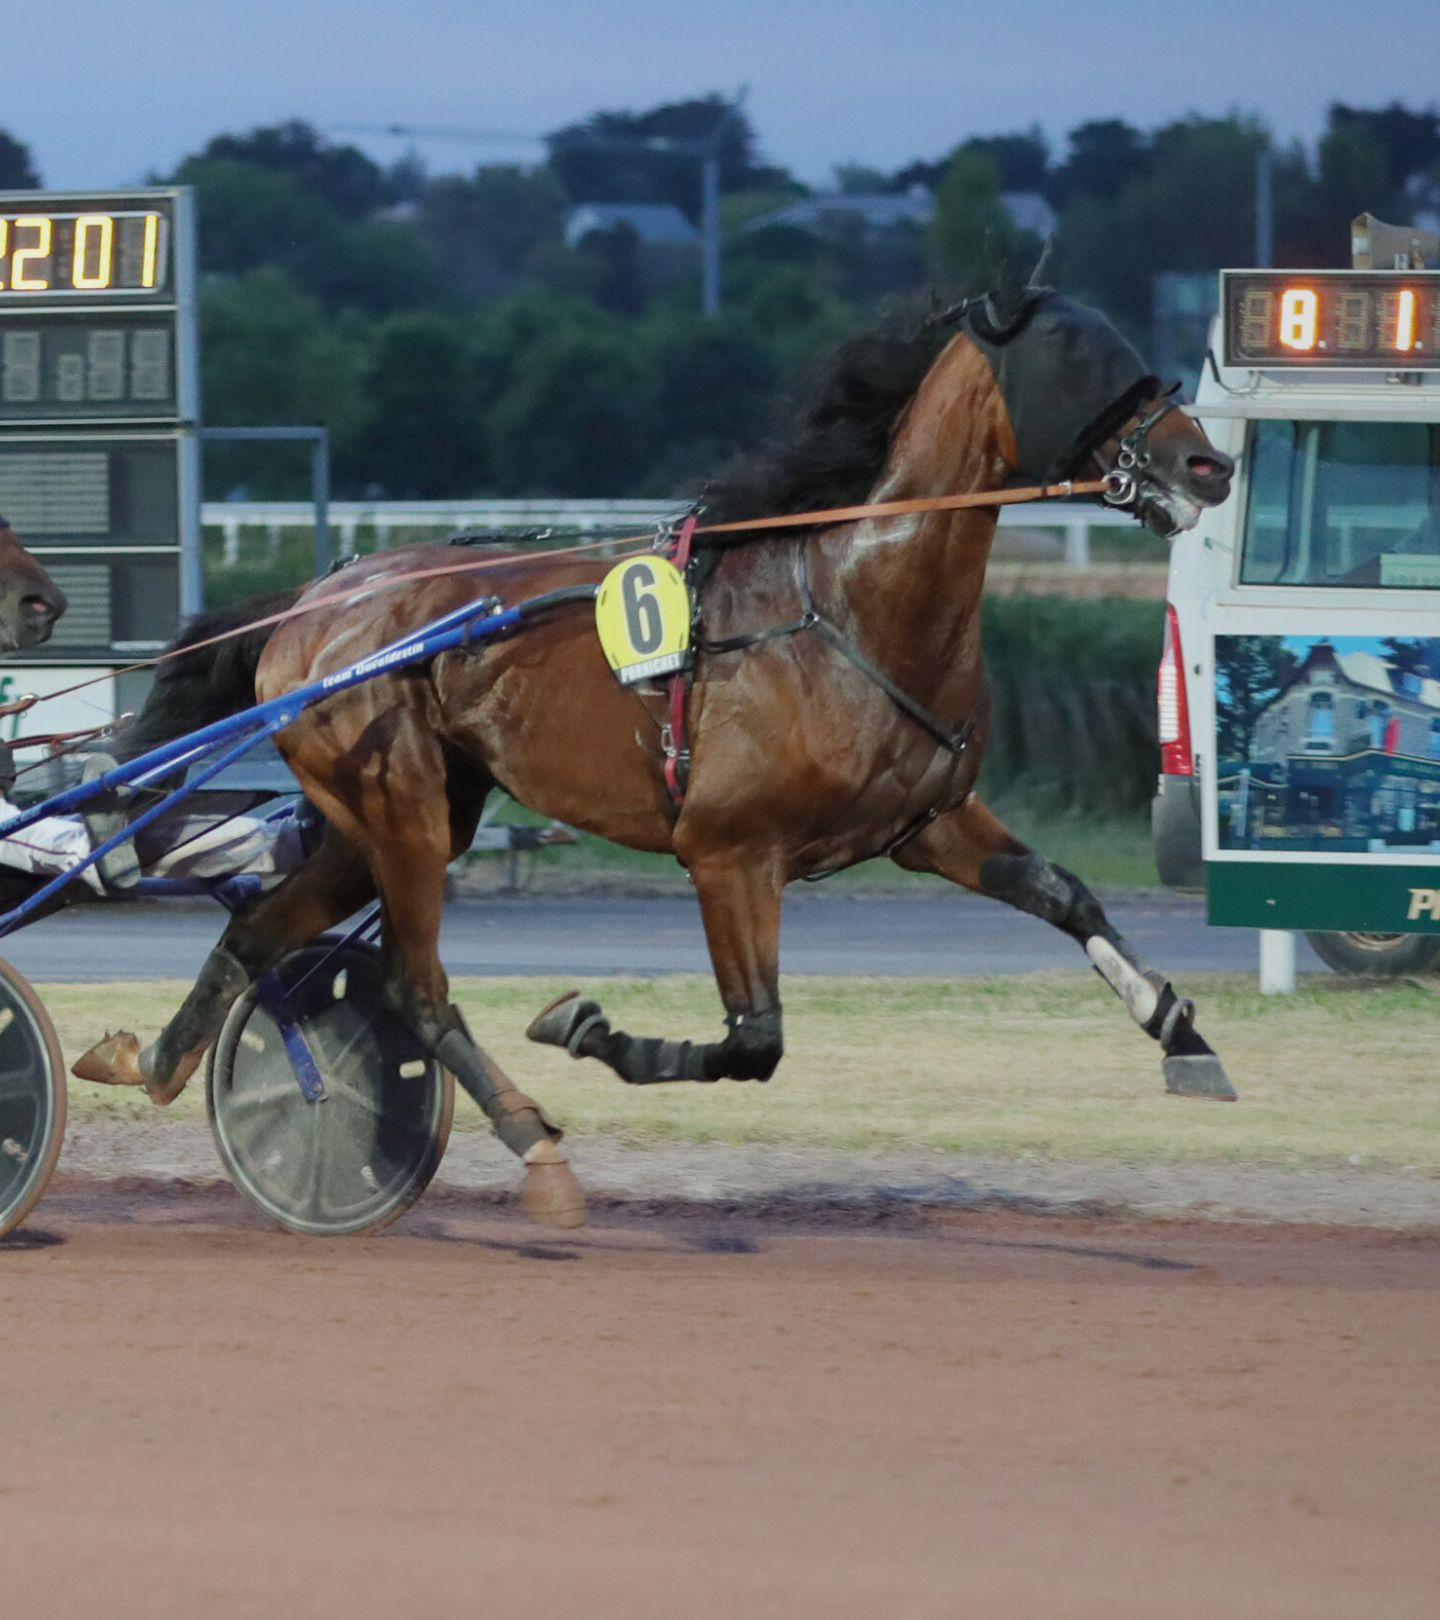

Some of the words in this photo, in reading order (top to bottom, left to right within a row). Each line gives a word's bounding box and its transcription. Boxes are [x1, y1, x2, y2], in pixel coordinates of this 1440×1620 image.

[72, 214, 157, 289] 01
[621, 562, 663, 655] 6
[322, 671, 352, 688] Team
[620, 652, 680, 684] PORNICHET
